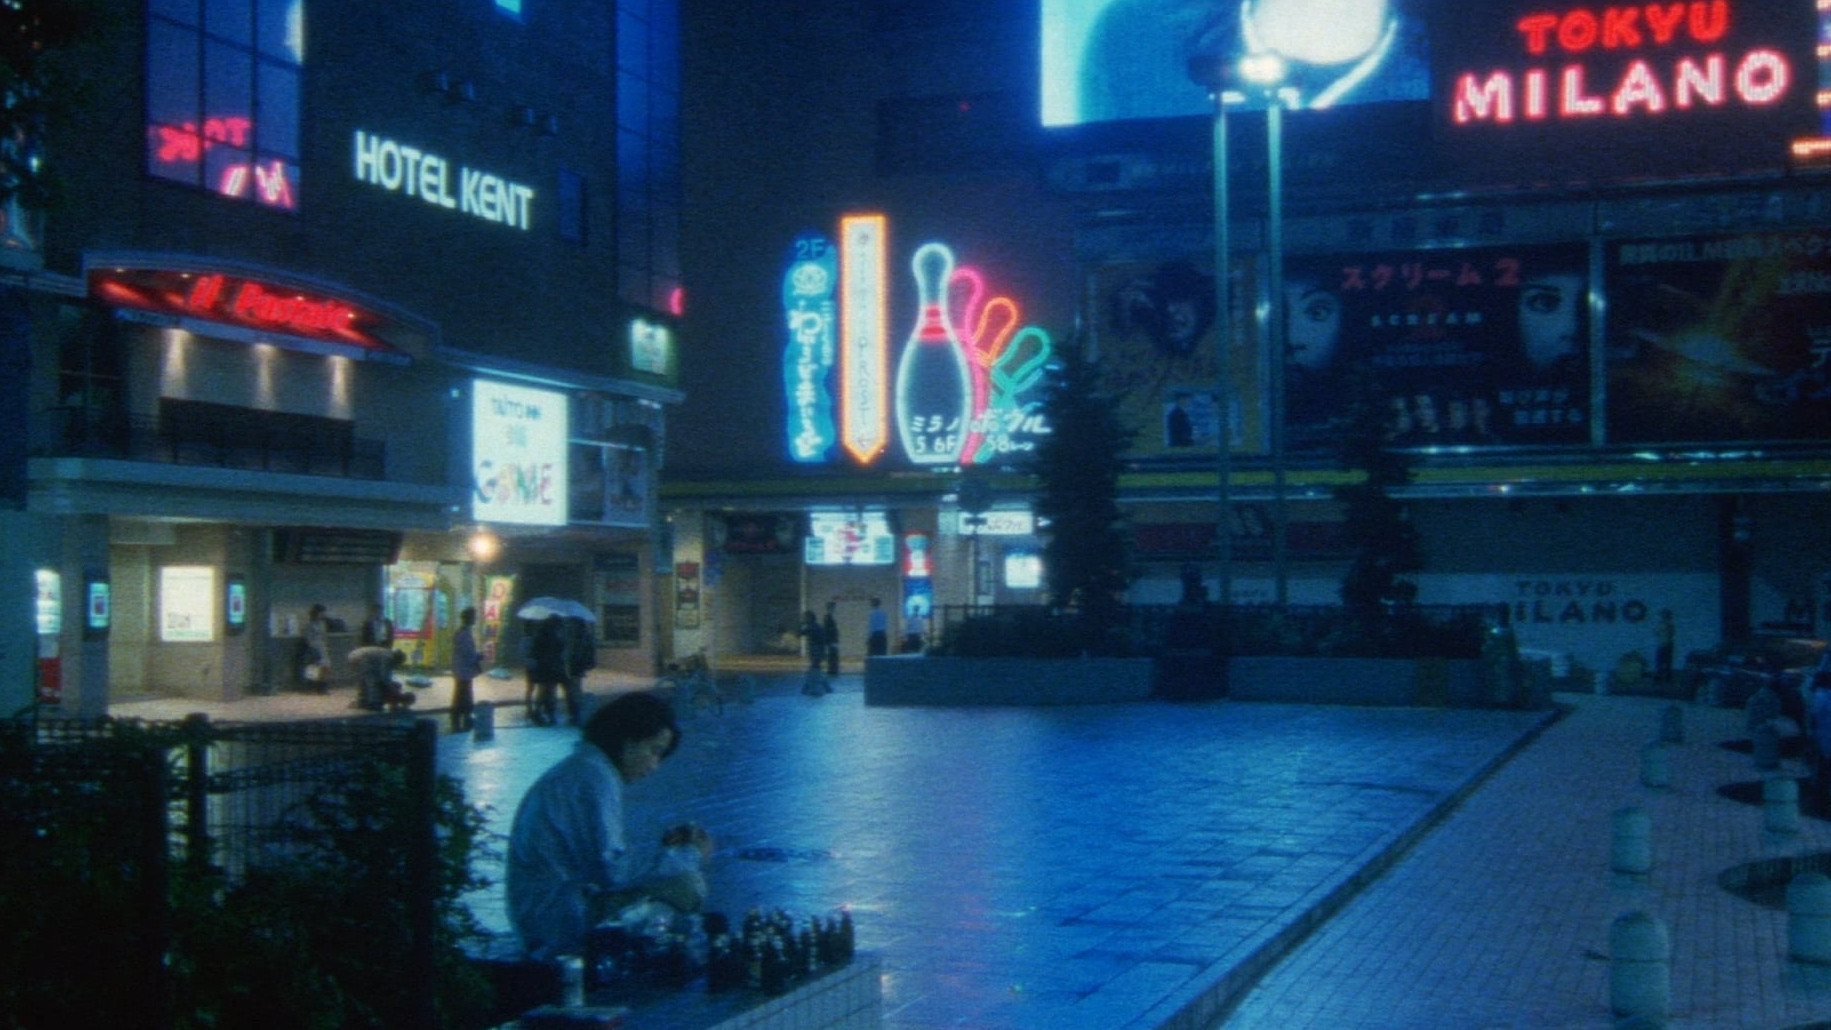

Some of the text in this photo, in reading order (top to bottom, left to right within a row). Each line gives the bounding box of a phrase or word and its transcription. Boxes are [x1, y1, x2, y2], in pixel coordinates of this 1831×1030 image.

[1517, 0, 1729, 54] TOKYU
[1453, 49, 1791, 125] MILANO
[354, 130, 535, 230] HOTEL KENT
[795, 239, 826, 259] 2F
[1341, 257, 1521, 290] スクリーム 2
[1370, 312, 1484, 327] SCREAM
[911, 402, 1052, 434] ミラノ ボウル
[1516, 581, 1614, 597] TOKYU
